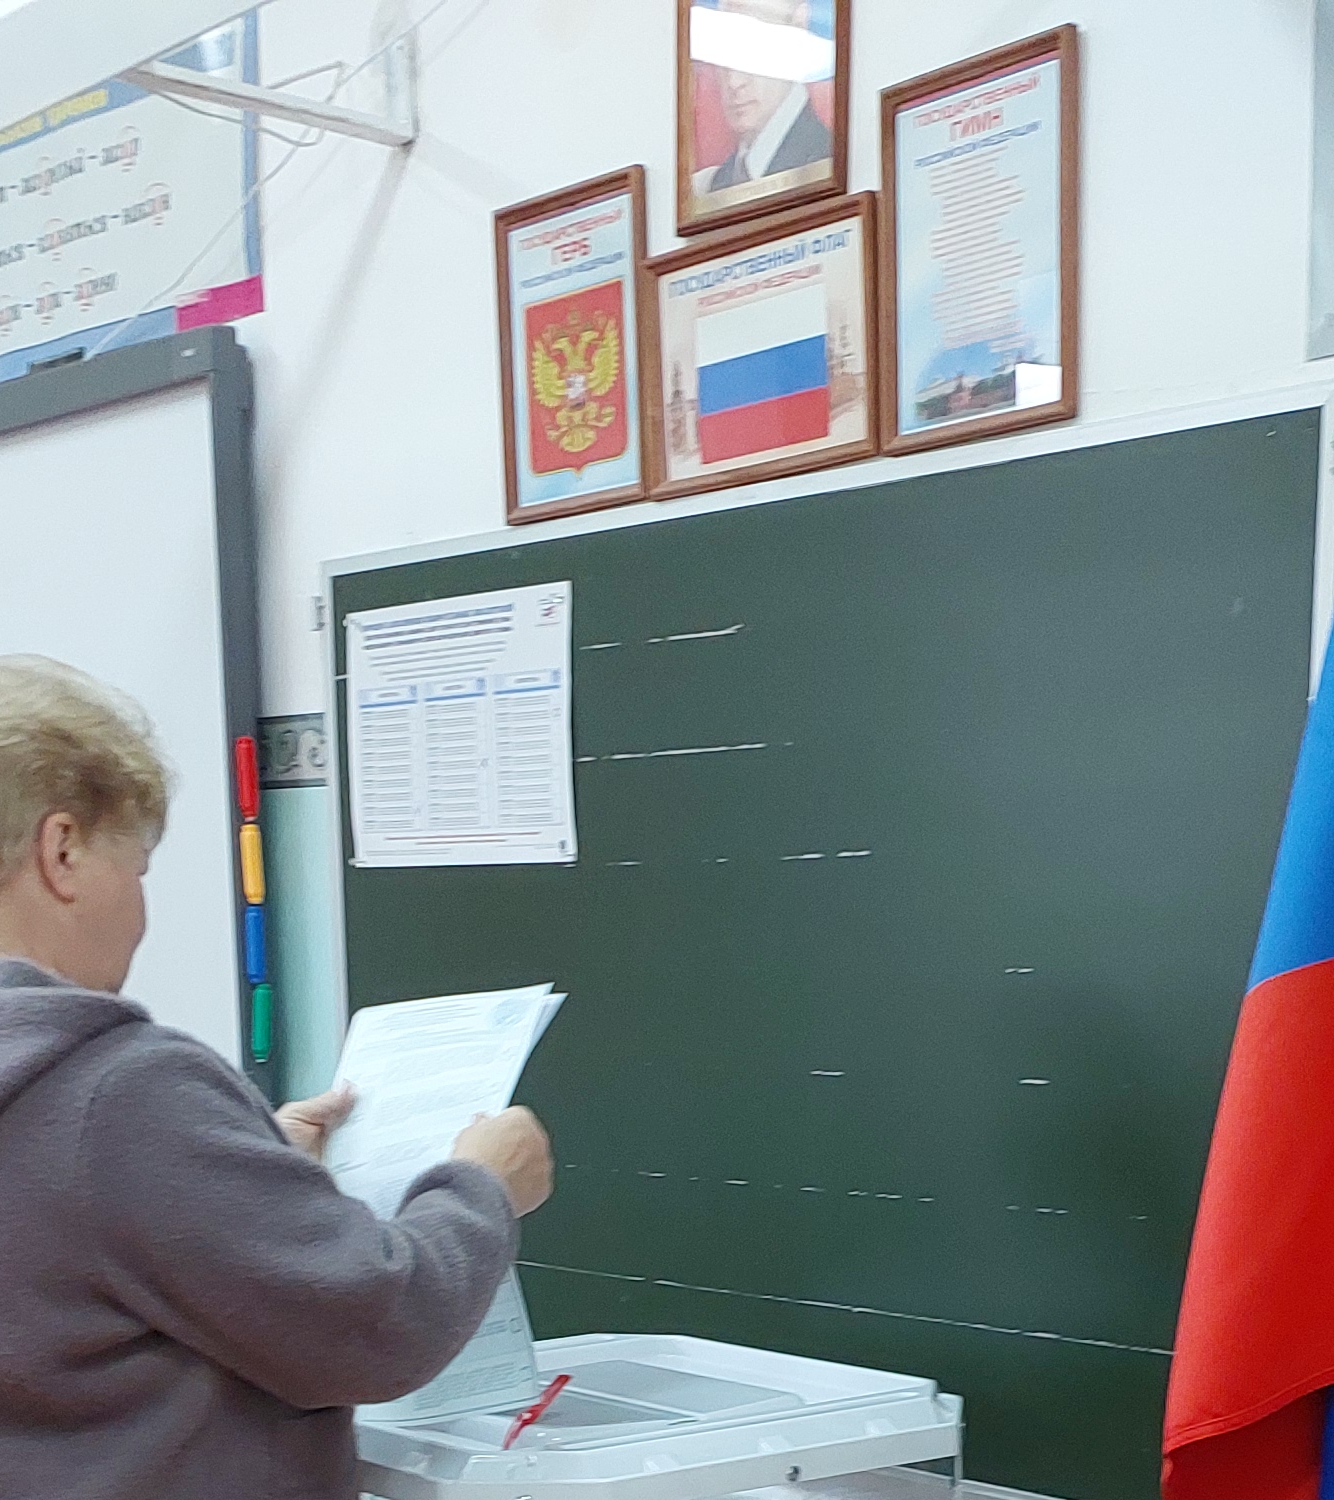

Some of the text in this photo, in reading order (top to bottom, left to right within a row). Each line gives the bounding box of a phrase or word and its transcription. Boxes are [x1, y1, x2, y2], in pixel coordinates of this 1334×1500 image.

[949, 107, 1004, 142] ГИМН
[550, 236, 591, 265] ГЕРБ
[669, 227, 853, 299] ГОСУДАРСТВЕННЫЙ ФЛАГ
